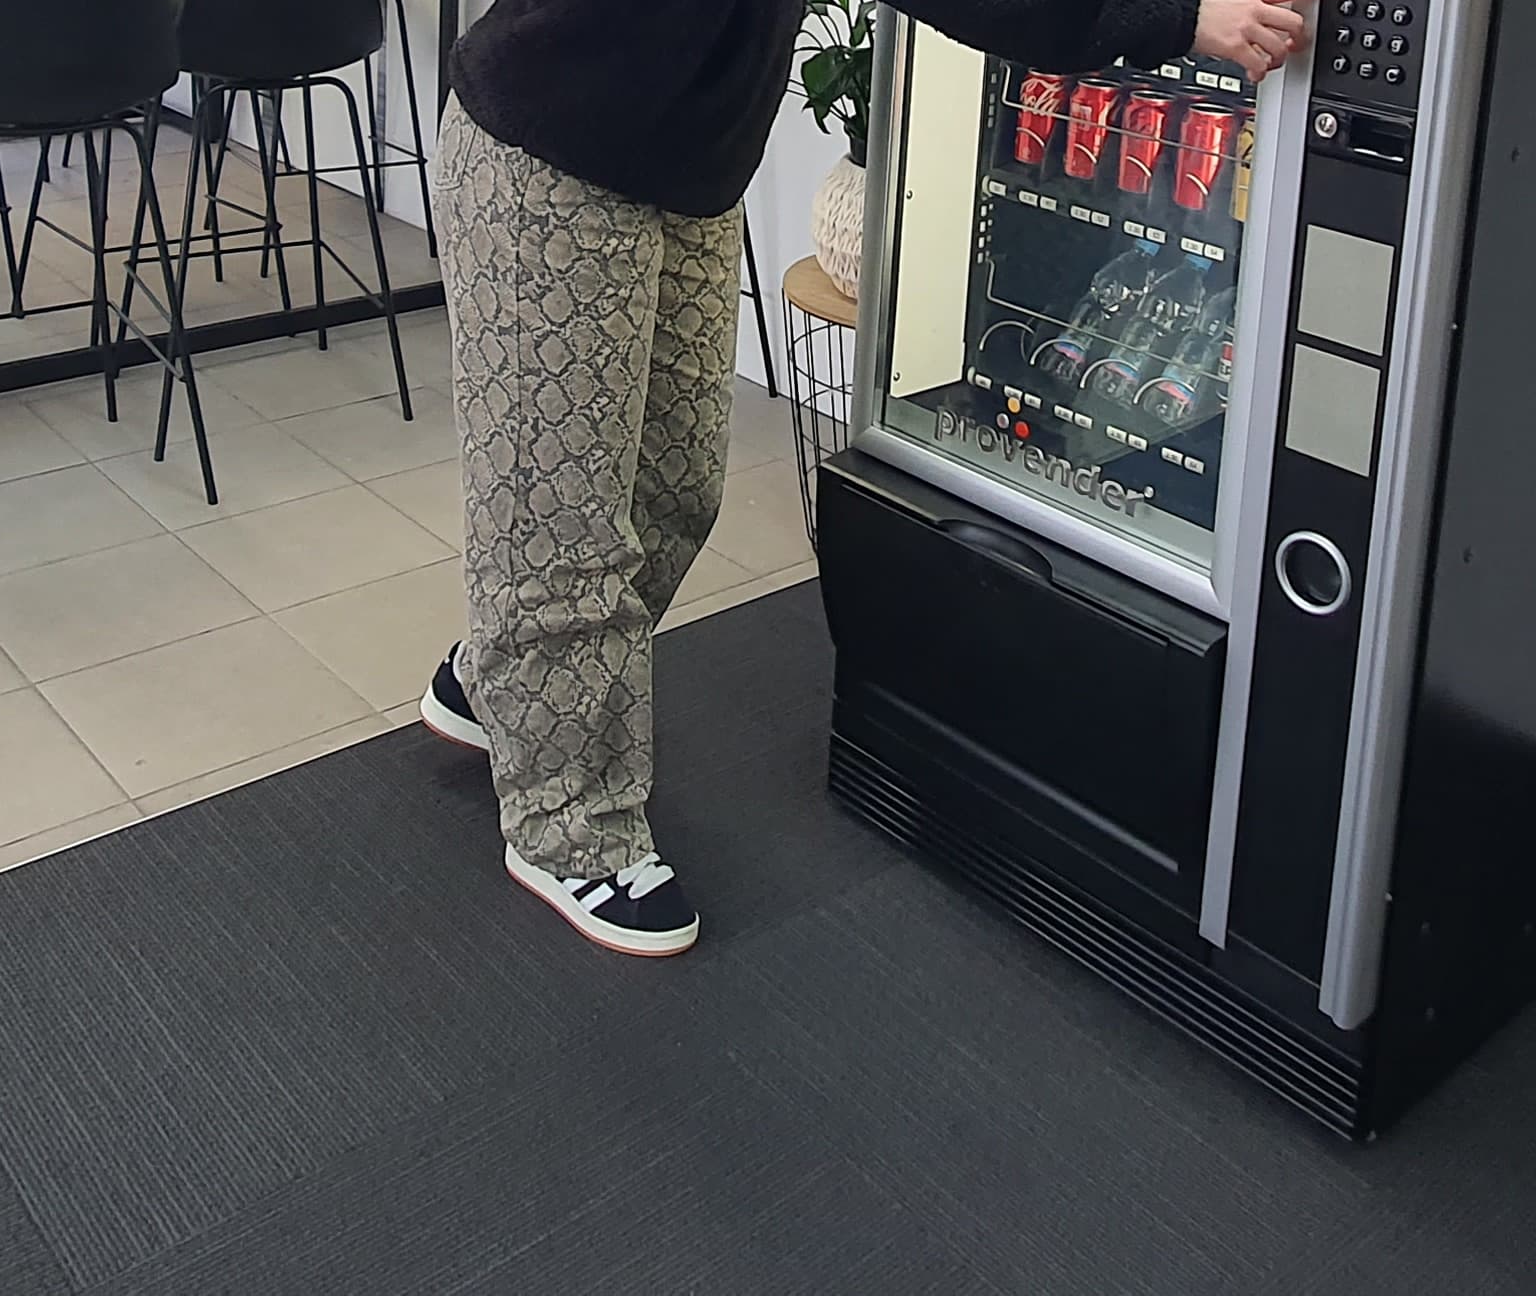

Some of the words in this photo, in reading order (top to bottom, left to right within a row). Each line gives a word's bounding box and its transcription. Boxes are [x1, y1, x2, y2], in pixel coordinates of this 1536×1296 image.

[1367, 4, 1379, 18] 5
[1393, 9, 1407, 22] 6
[1338, 29, 1350, 42] 7
[1363, 34, 1376, 47] 8
[1391, 38, 1403, 52] 9
[1360, 63, 1373, 77] E
[1386, 68, 1400, 82] C
[934, 406, 1145, 517] provender
